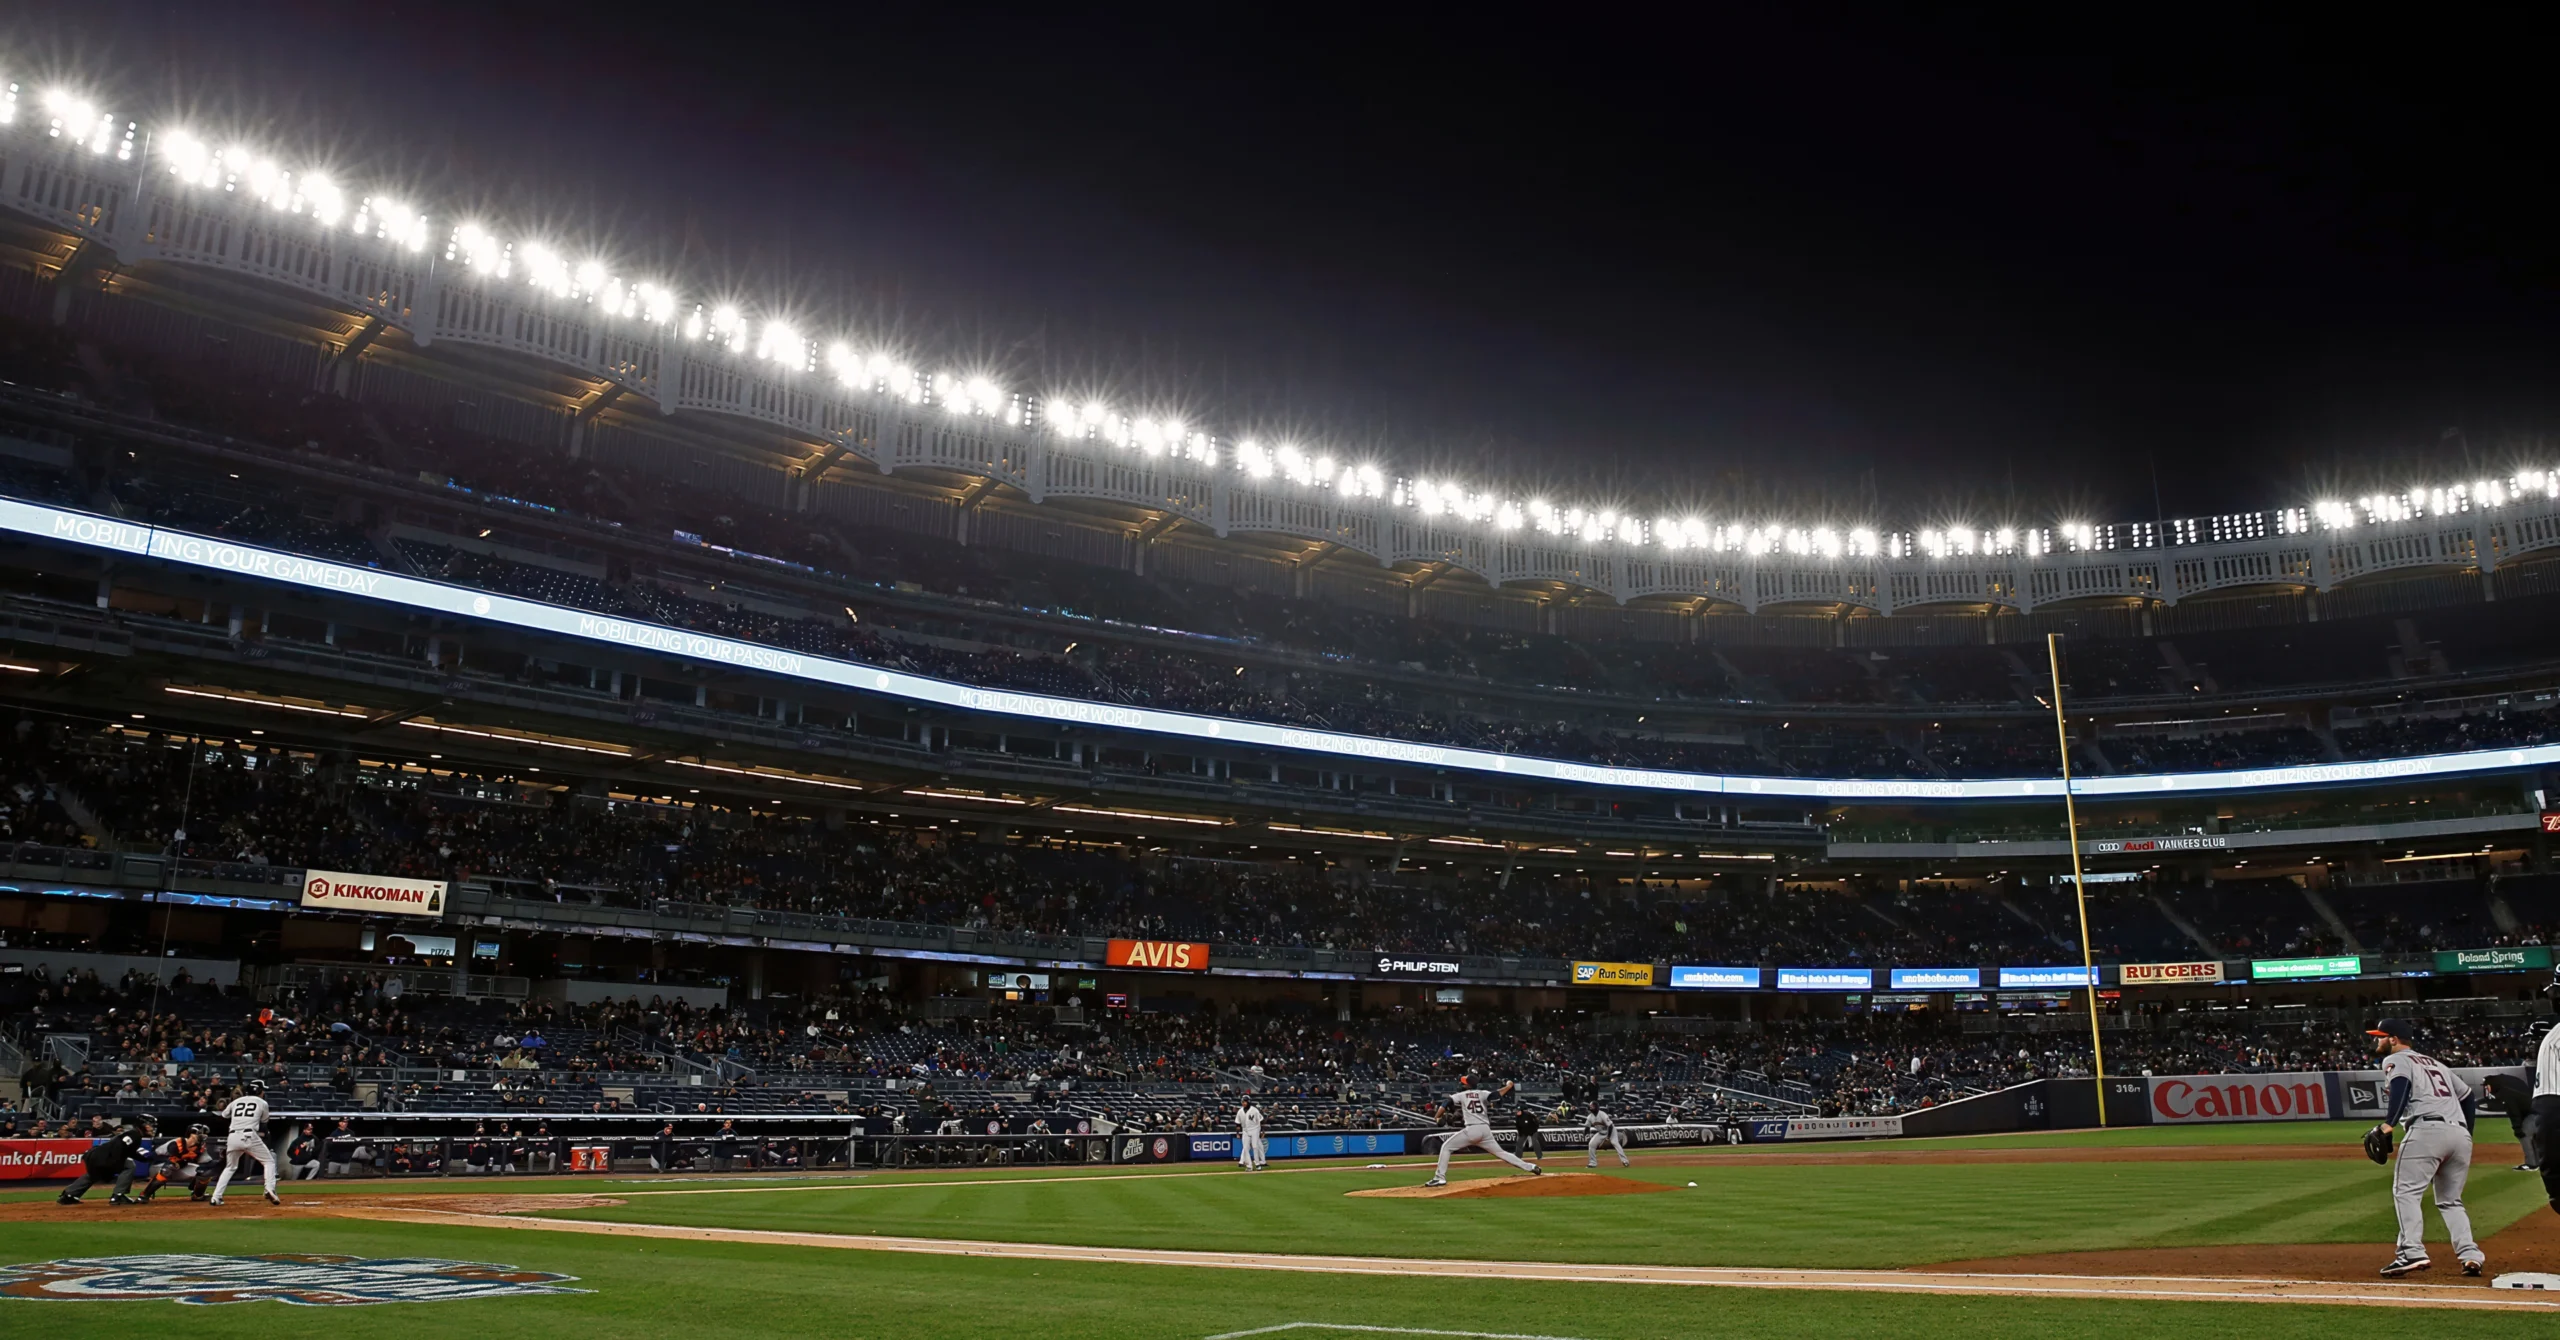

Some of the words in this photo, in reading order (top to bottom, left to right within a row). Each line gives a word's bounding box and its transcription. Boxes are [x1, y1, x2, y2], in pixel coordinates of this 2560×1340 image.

[54, 515, 200, 560] MOBILIZING
[206, 544, 269, 574] YOUR
[274, 559, 381, 594] GAMEDAY
[579, 617, 682, 651] MOBILIZING
[685, 637, 731, 660] YOUR
[733, 648, 803, 673] PASSION
[958, 689, 1045, 715] MOBILIZING
[1048, 701, 1088, 720] YOUR
[1090, 706, 1142, 726] WORLD
[1281, 731, 1353, 751] MOBILIZING
[1355, 741, 1389, 756] YOUR
[1389, 744, 1446, 762] GAMEDAY
[1617, 770, 1649, 785] YOUR
[1649, 773, 1695, 788] PASSION
[2242, 769, 2322, 785] MOBILIZING
[2323, 765, 2362, 779] YOUR
[2364, 759, 2434, 777] GAMEDAY
[1886, 783, 1919, 796] YOUR
[2123, 841, 2155, 851] Audi
[2158, 839, 2200, 850] YANKEES
[2202, 838, 2226, 848] CLUB
[333, 883, 424, 903] KIKKOMAN
[430, 948, 451, 956] PIZZA
[1126, 941, 1191, 968] AVIS
[2457, 952, 2490, 965] Poland
[2491, 950, 2525, 964] Spring
[1393, 961, 1428, 972] PHILIP
[1428, 962, 1459, 973] STEIN
[1577, 966, 1595, 978] SAP
[1598, 968, 1616, 979] Run
[1618, 968, 1649, 982] Simple
[2125, 963, 2216, 979] RUTGERS
[2424, 1069, 2453, 1098] 13
[1466, 1100, 1484, 1114] 45
[2152, 1079, 2326, 1119] Canon
[234, 1102, 258, 1117] 22
[1757, 1123, 1783, 1134] ACC
[1192, 1140, 1231, 1152] GEICO
[0, 1151, 22, 1166] nk
[24, 1151, 41, 1165] of
[42, 1150, 86, 1166] Amer
